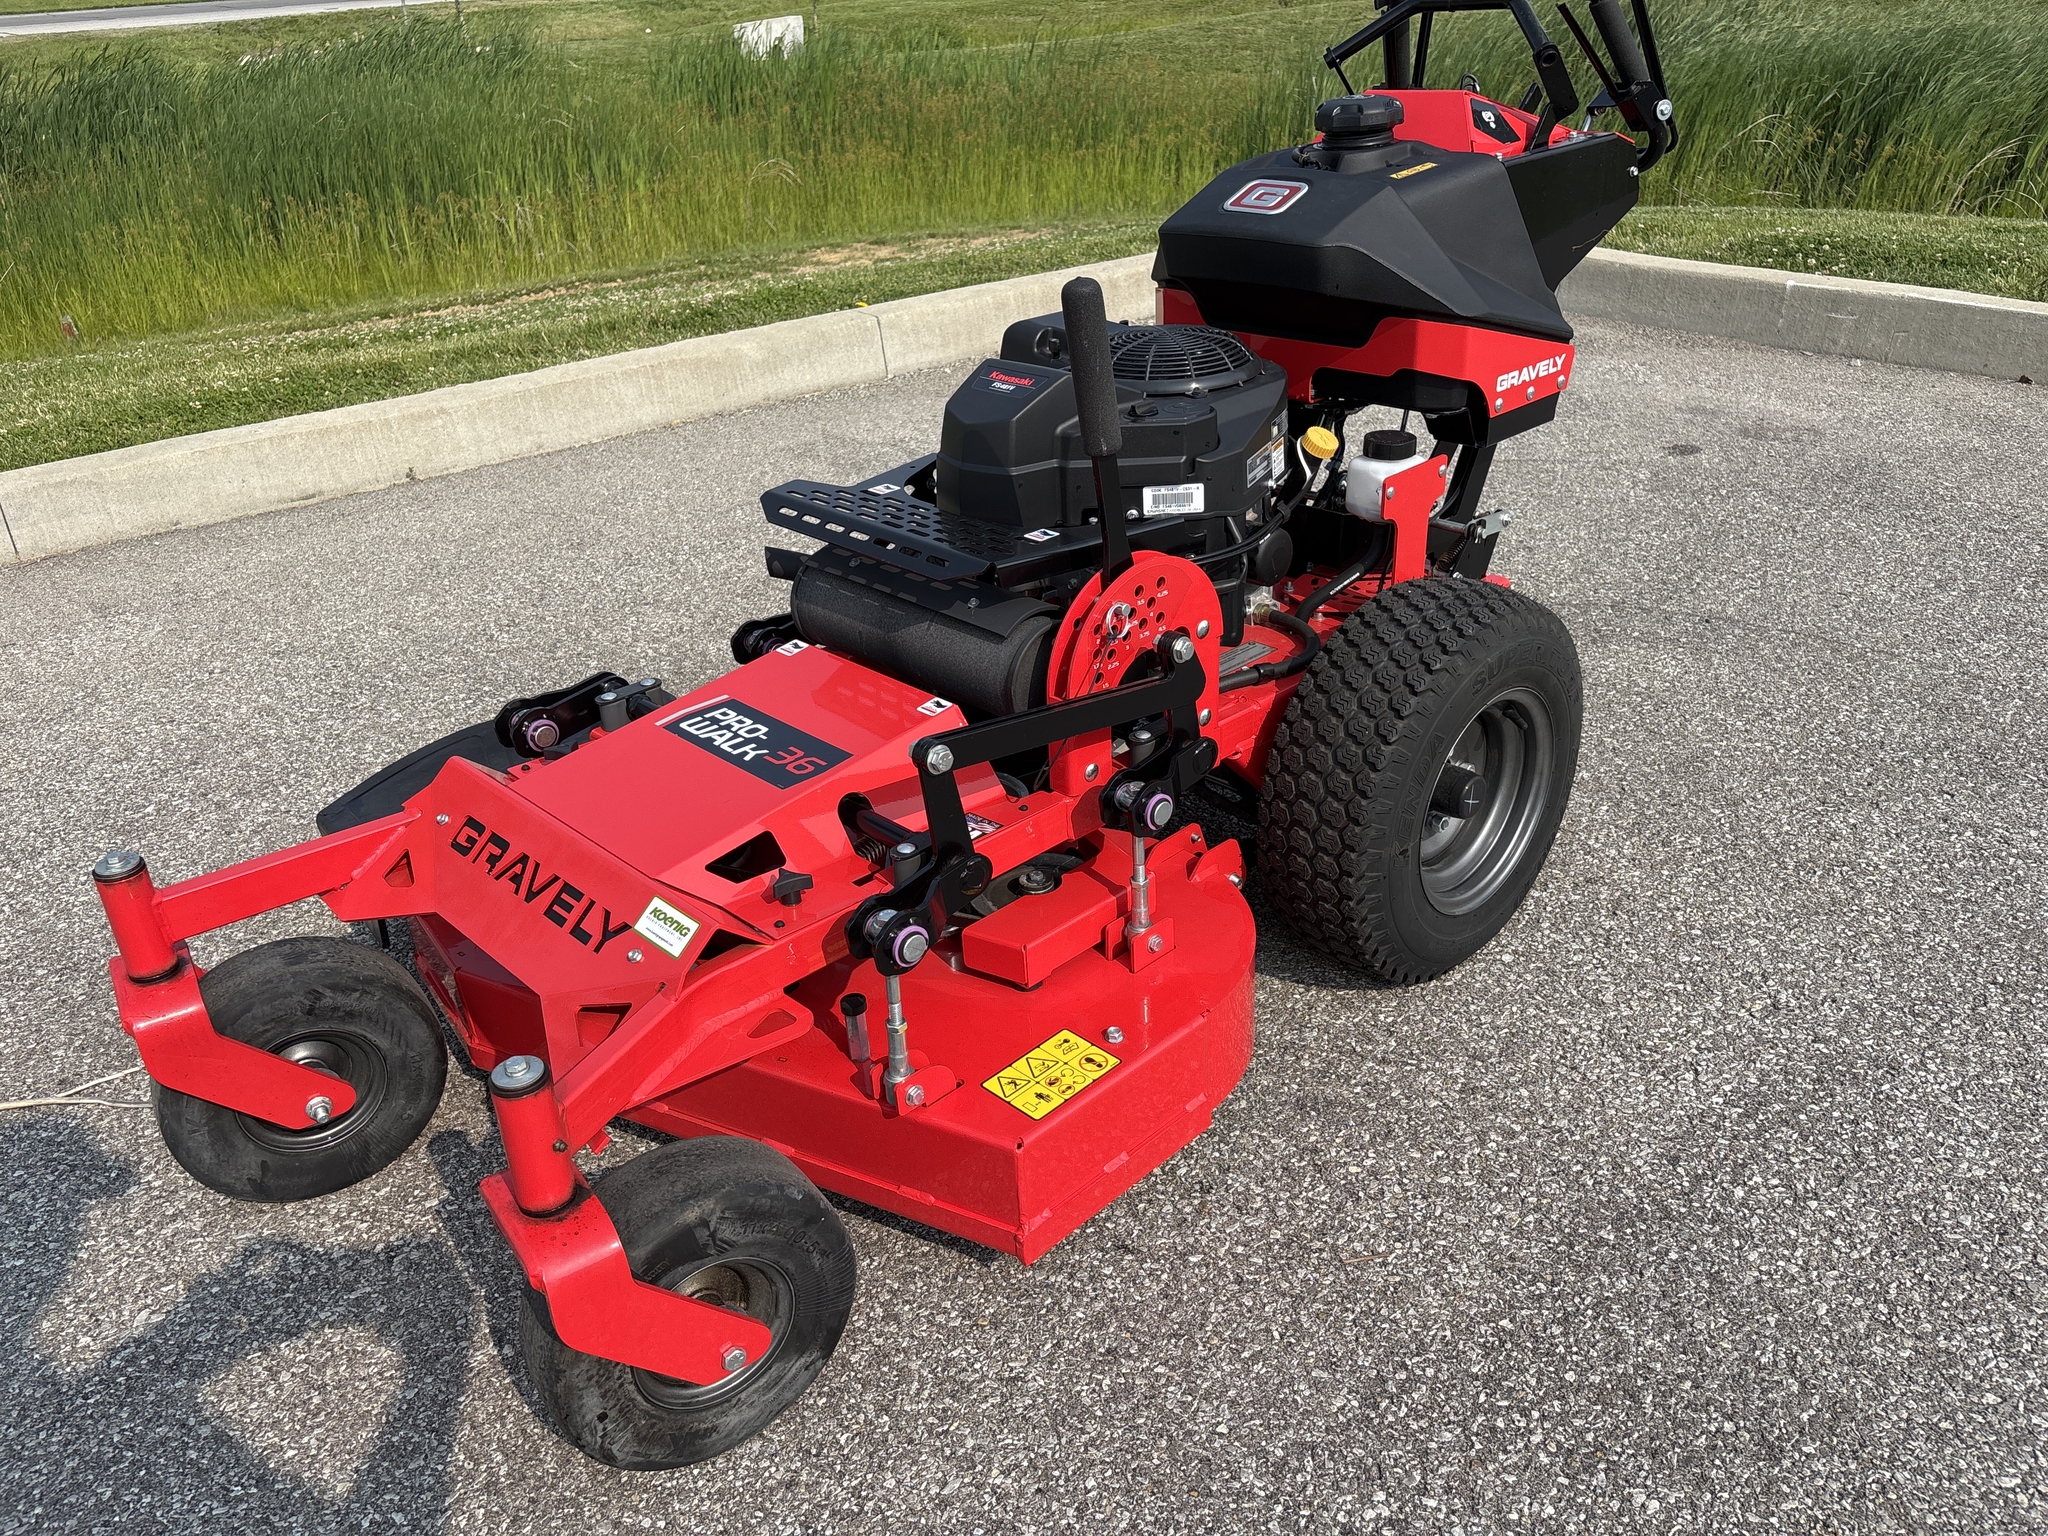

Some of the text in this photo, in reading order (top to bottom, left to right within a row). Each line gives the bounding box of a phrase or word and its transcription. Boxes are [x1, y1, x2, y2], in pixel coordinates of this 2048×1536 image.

[989, 371, 1036, 386] Kawasaki
[1496, 353, 1567, 393] GRAVELY
[1139, 630, 1150, 639] 3.75
[1471, 641, 1546, 698] SUPER
[679, 716, 828, 775] WALK 36
[703, 707, 769, 740] PRO-
[1393, 732, 1447, 868] KENDA
[450, 814, 633, 955] GRAVELY
